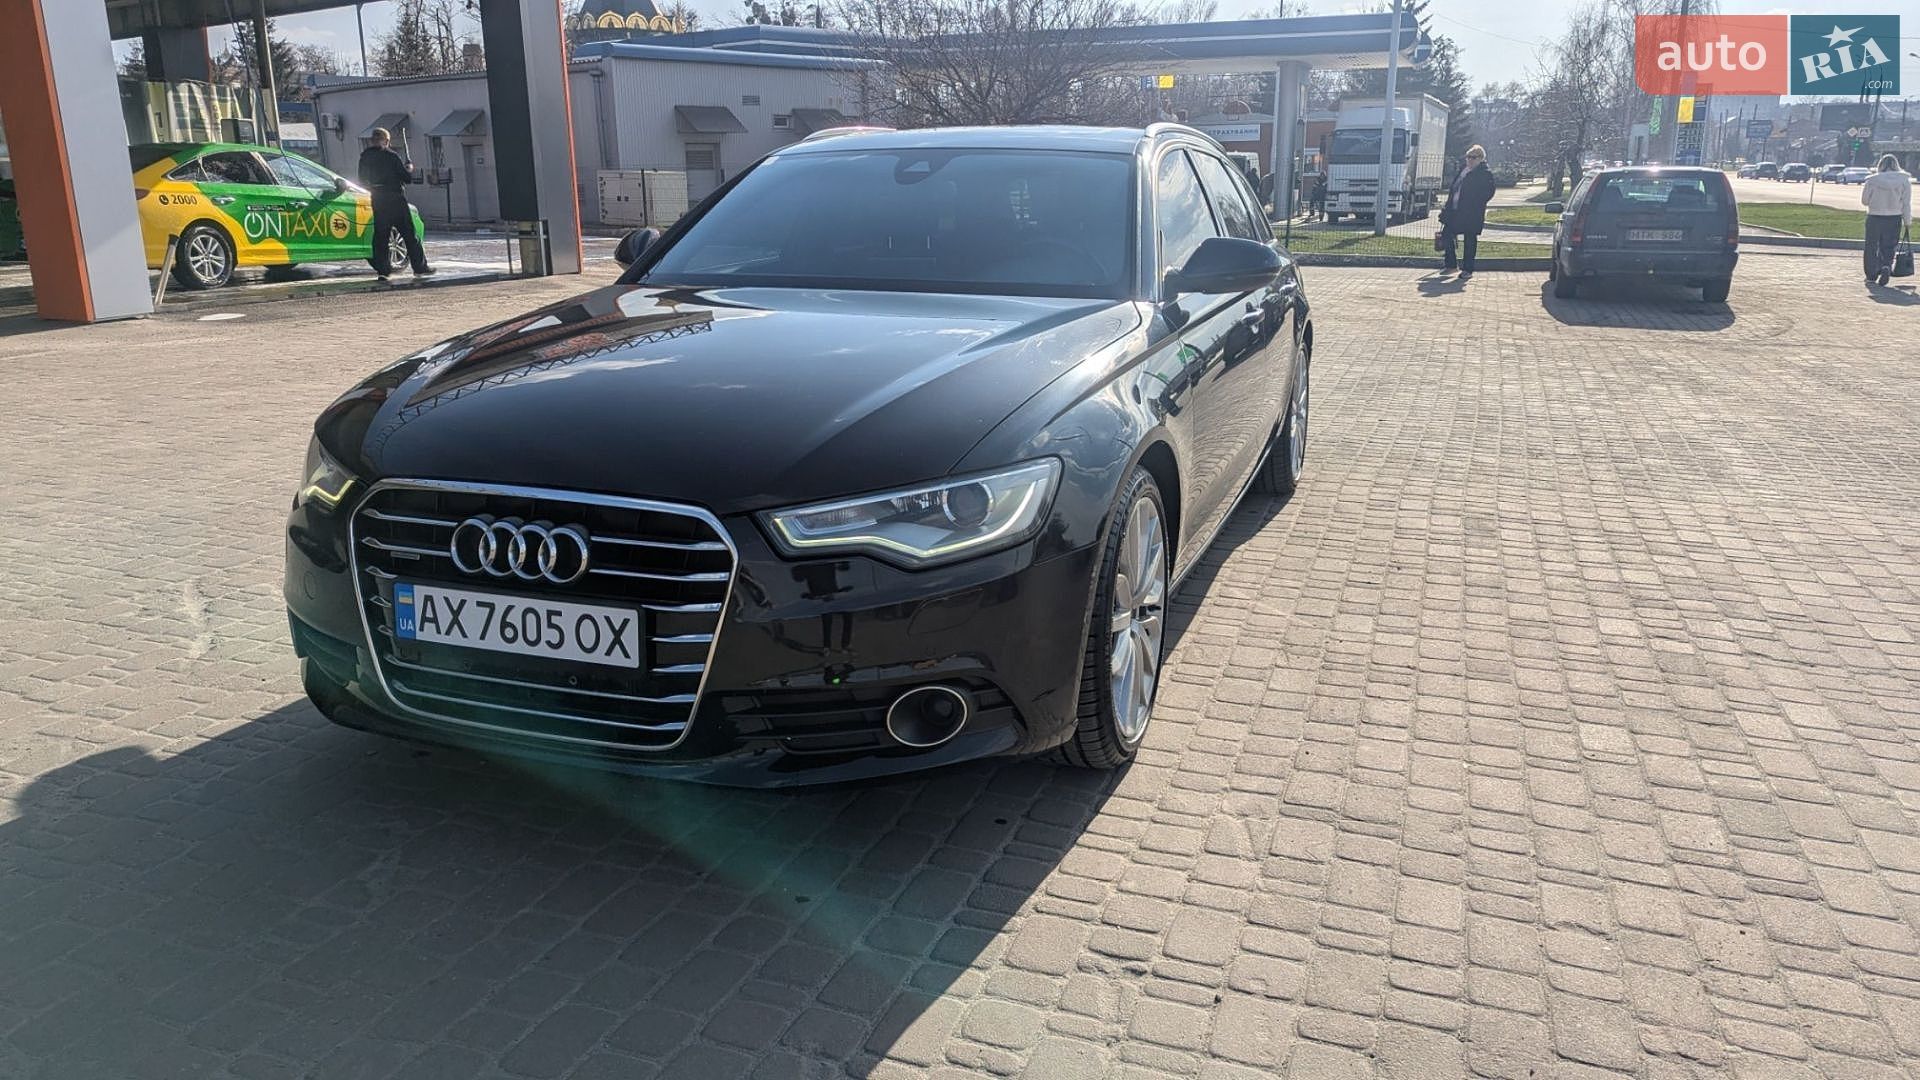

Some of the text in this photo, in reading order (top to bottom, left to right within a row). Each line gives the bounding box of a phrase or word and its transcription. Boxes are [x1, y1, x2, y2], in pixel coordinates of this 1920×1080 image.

[171, 194, 198, 205] 2000
[399, 618, 415, 631] UA
[418, 594, 632, 660] AX 7605 OX
